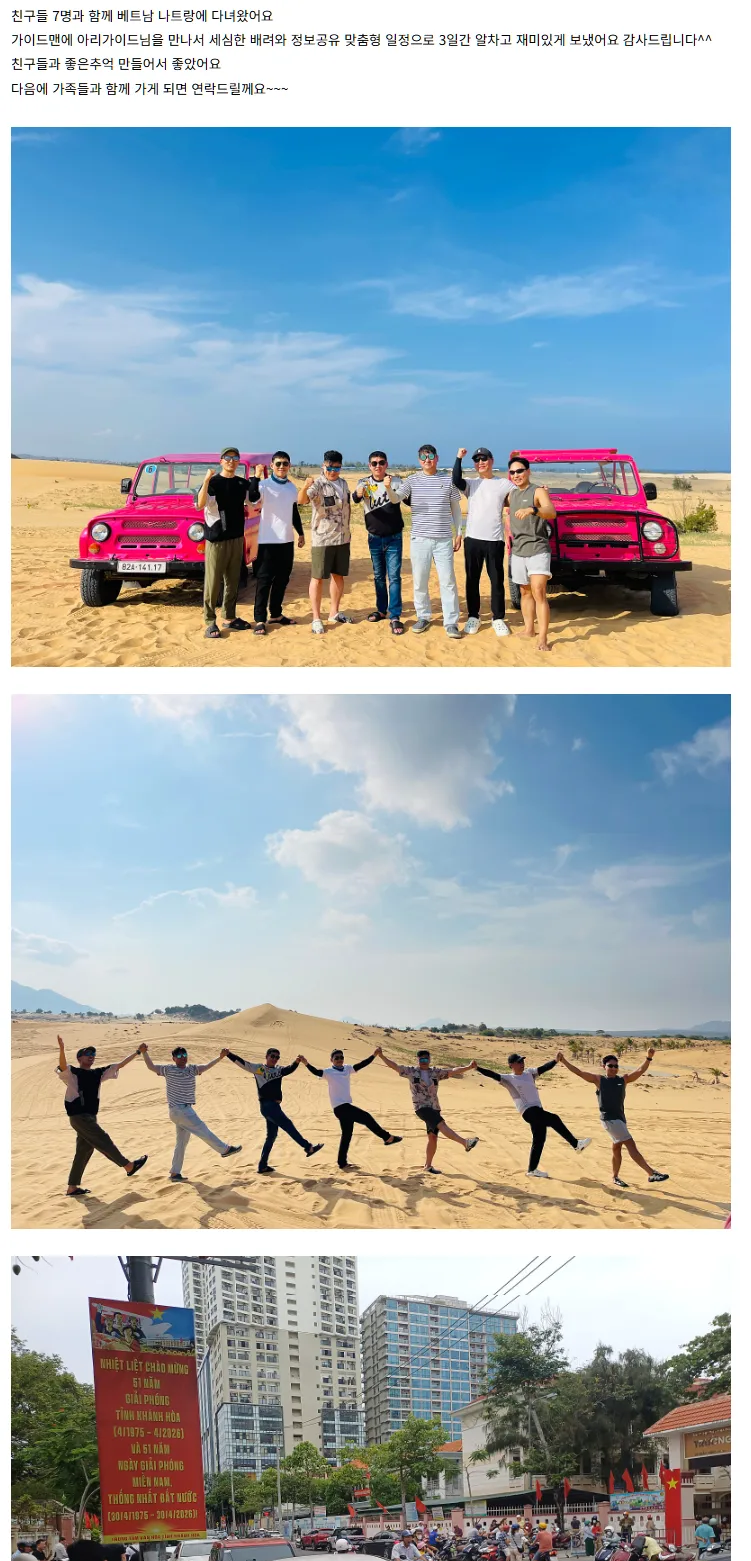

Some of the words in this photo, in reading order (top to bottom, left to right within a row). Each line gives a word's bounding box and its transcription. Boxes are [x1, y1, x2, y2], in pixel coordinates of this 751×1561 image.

[146, 1361, 166, 1373] CHÀO
[133, 1378, 141, 1388] 51
[144, 1376, 160, 1389] NĂM
[143, 1444, 151, 1454] 51
